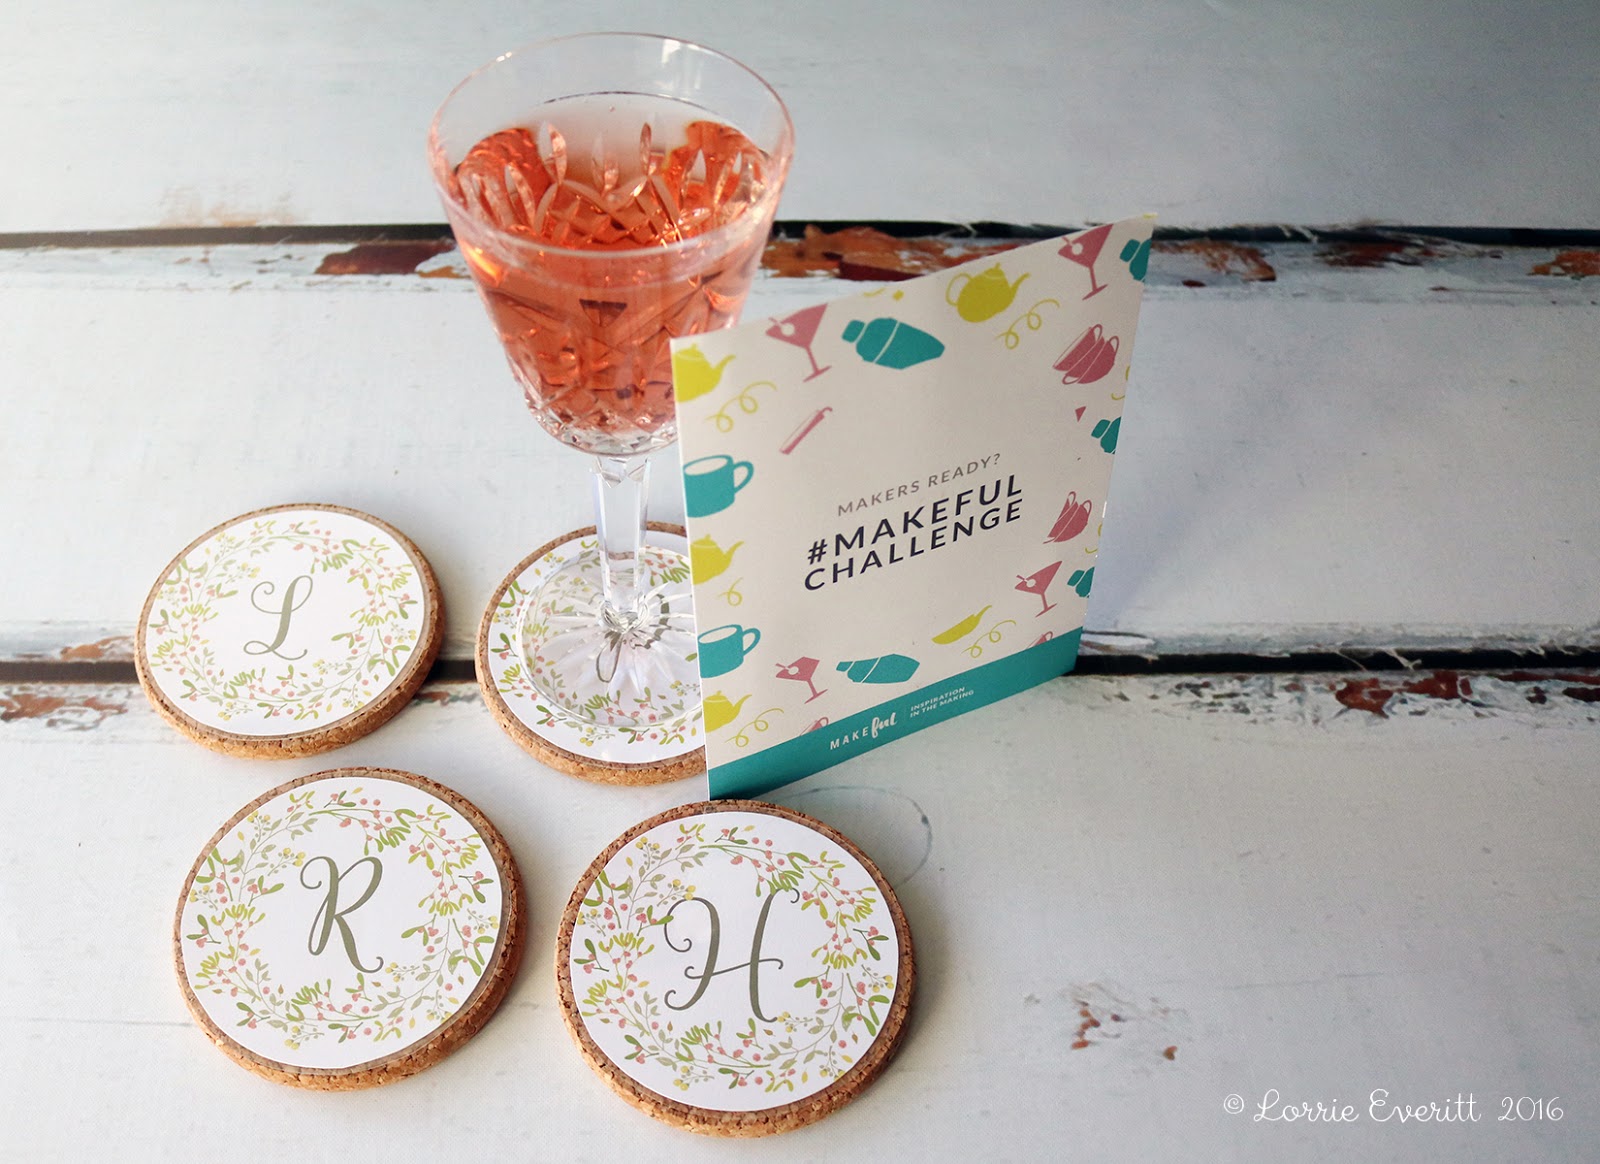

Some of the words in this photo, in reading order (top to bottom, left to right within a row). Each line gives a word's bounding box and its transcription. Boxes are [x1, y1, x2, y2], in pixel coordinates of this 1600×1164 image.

[807, 475, 1022, 565] #MAKEFUL
[838, 481, 920, 516] MAKERS
[928, 453, 1001, 487] READY?
[804, 498, 1023, 591] CHALLENGE
[243, 575, 313, 661] L
[910, 687, 965, 711] INSPIRATION
[910, 710, 919, 718] IN
[922, 703, 937, 713] THE
[939, 690, 974, 706] MAKING
[299, 856, 383, 974] R
[663, 888, 800, 1023] H
